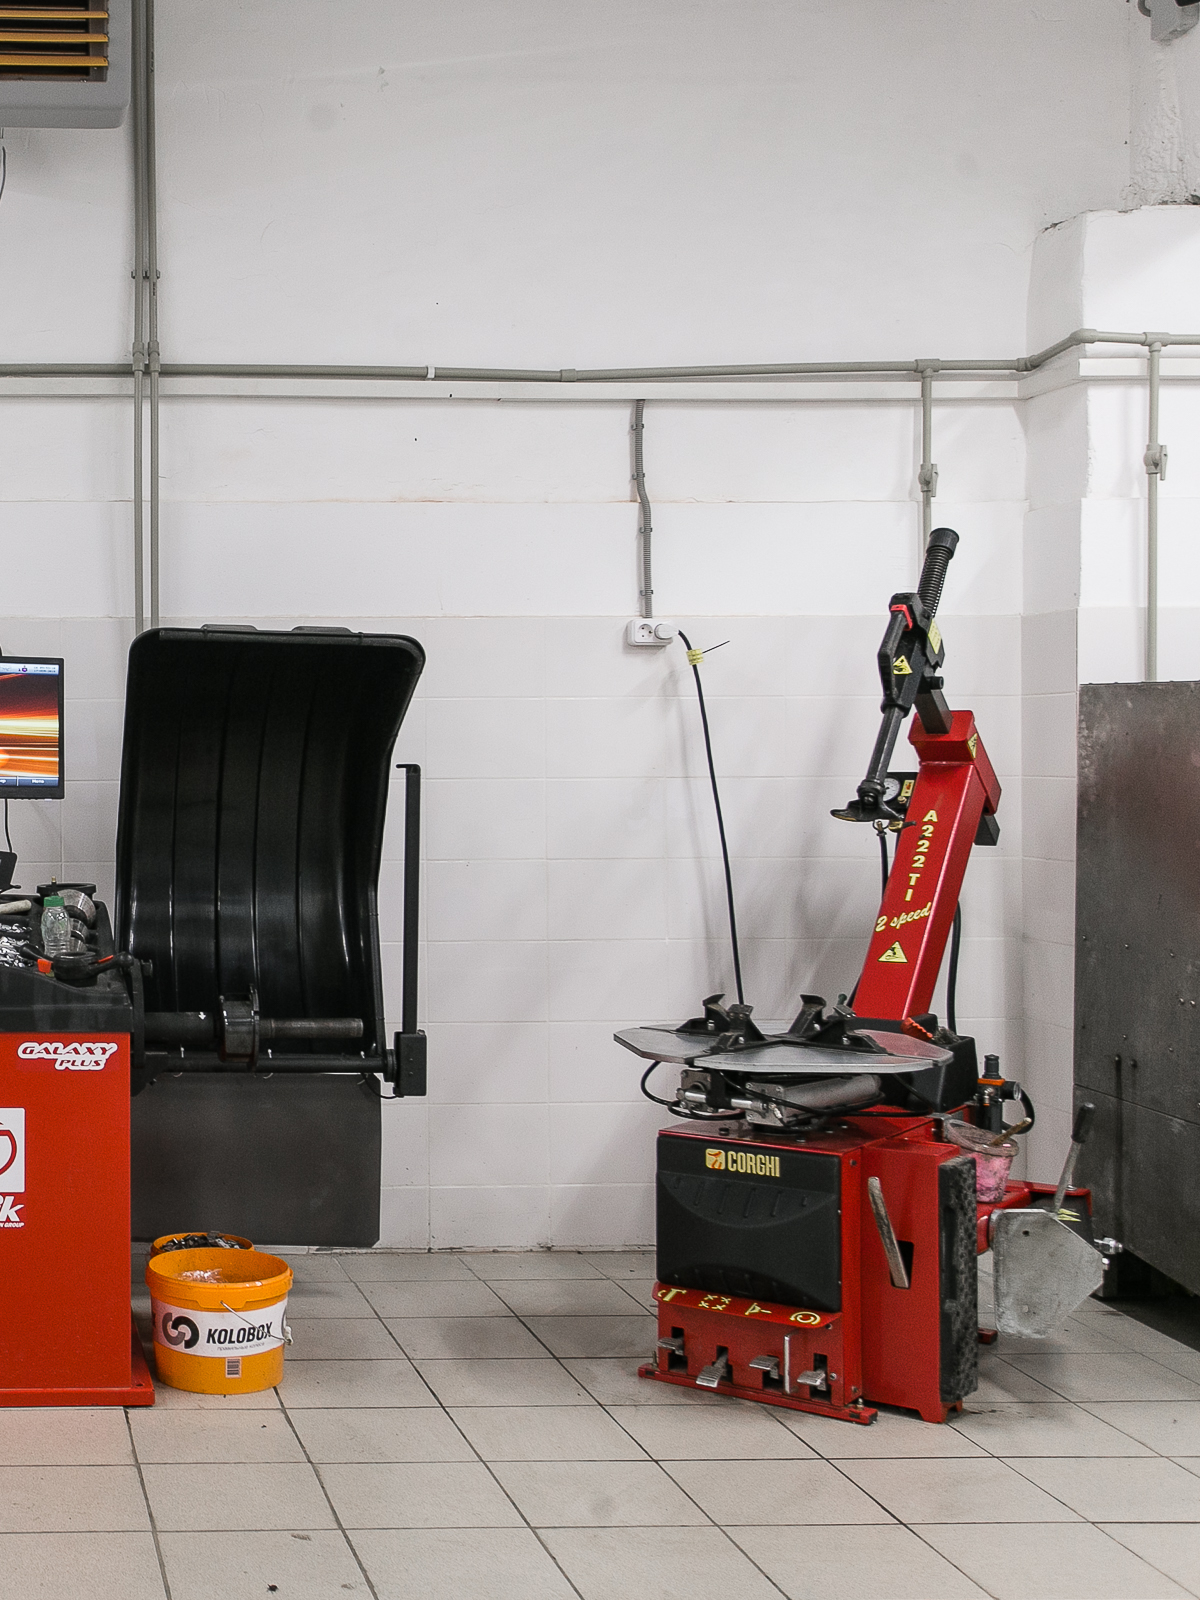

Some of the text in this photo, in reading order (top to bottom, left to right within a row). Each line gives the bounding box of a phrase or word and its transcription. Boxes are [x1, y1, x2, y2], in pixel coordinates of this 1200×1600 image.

[874, 902, 932, 932] 2 speed
[19, 1044, 116, 1057] GALAXY
[57, 1058, 104, 1069] PLUS
[727, 1150, 780, 1178] CORGHI
[206, 1321, 273, 1345] KOLOBOX
